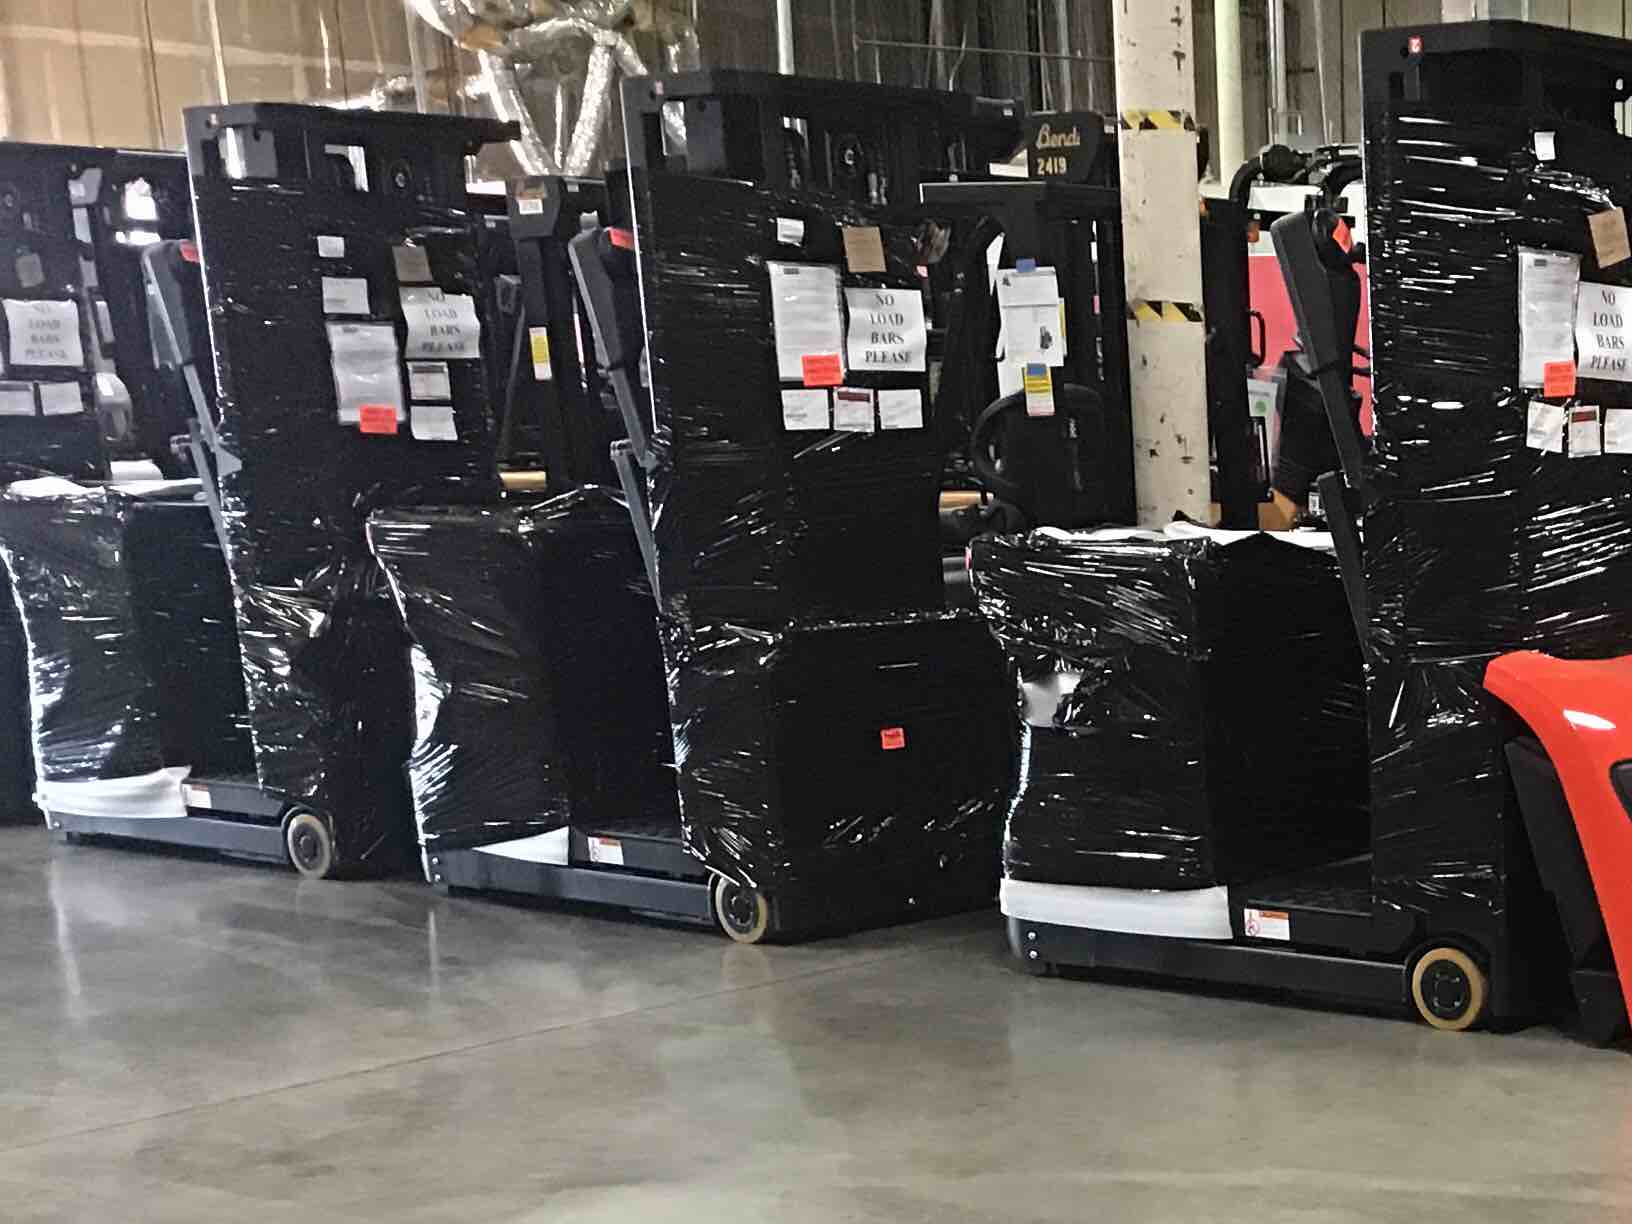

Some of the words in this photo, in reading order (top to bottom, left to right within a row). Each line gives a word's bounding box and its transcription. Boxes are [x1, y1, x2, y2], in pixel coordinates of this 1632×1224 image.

[1037, 157, 1067, 175] 2419
[876, 294, 895, 306] NO
[1601, 290, 1615, 305] NO
[869, 313, 904, 326] LOAD
[1593, 312, 1623, 328] LOAD
[871, 332, 904, 345] BARS
[1596, 334, 1625, 350] BARS
[865, 351, 913, 364] PLEASE
[1590, 355, 1628, 371] PLEASE
